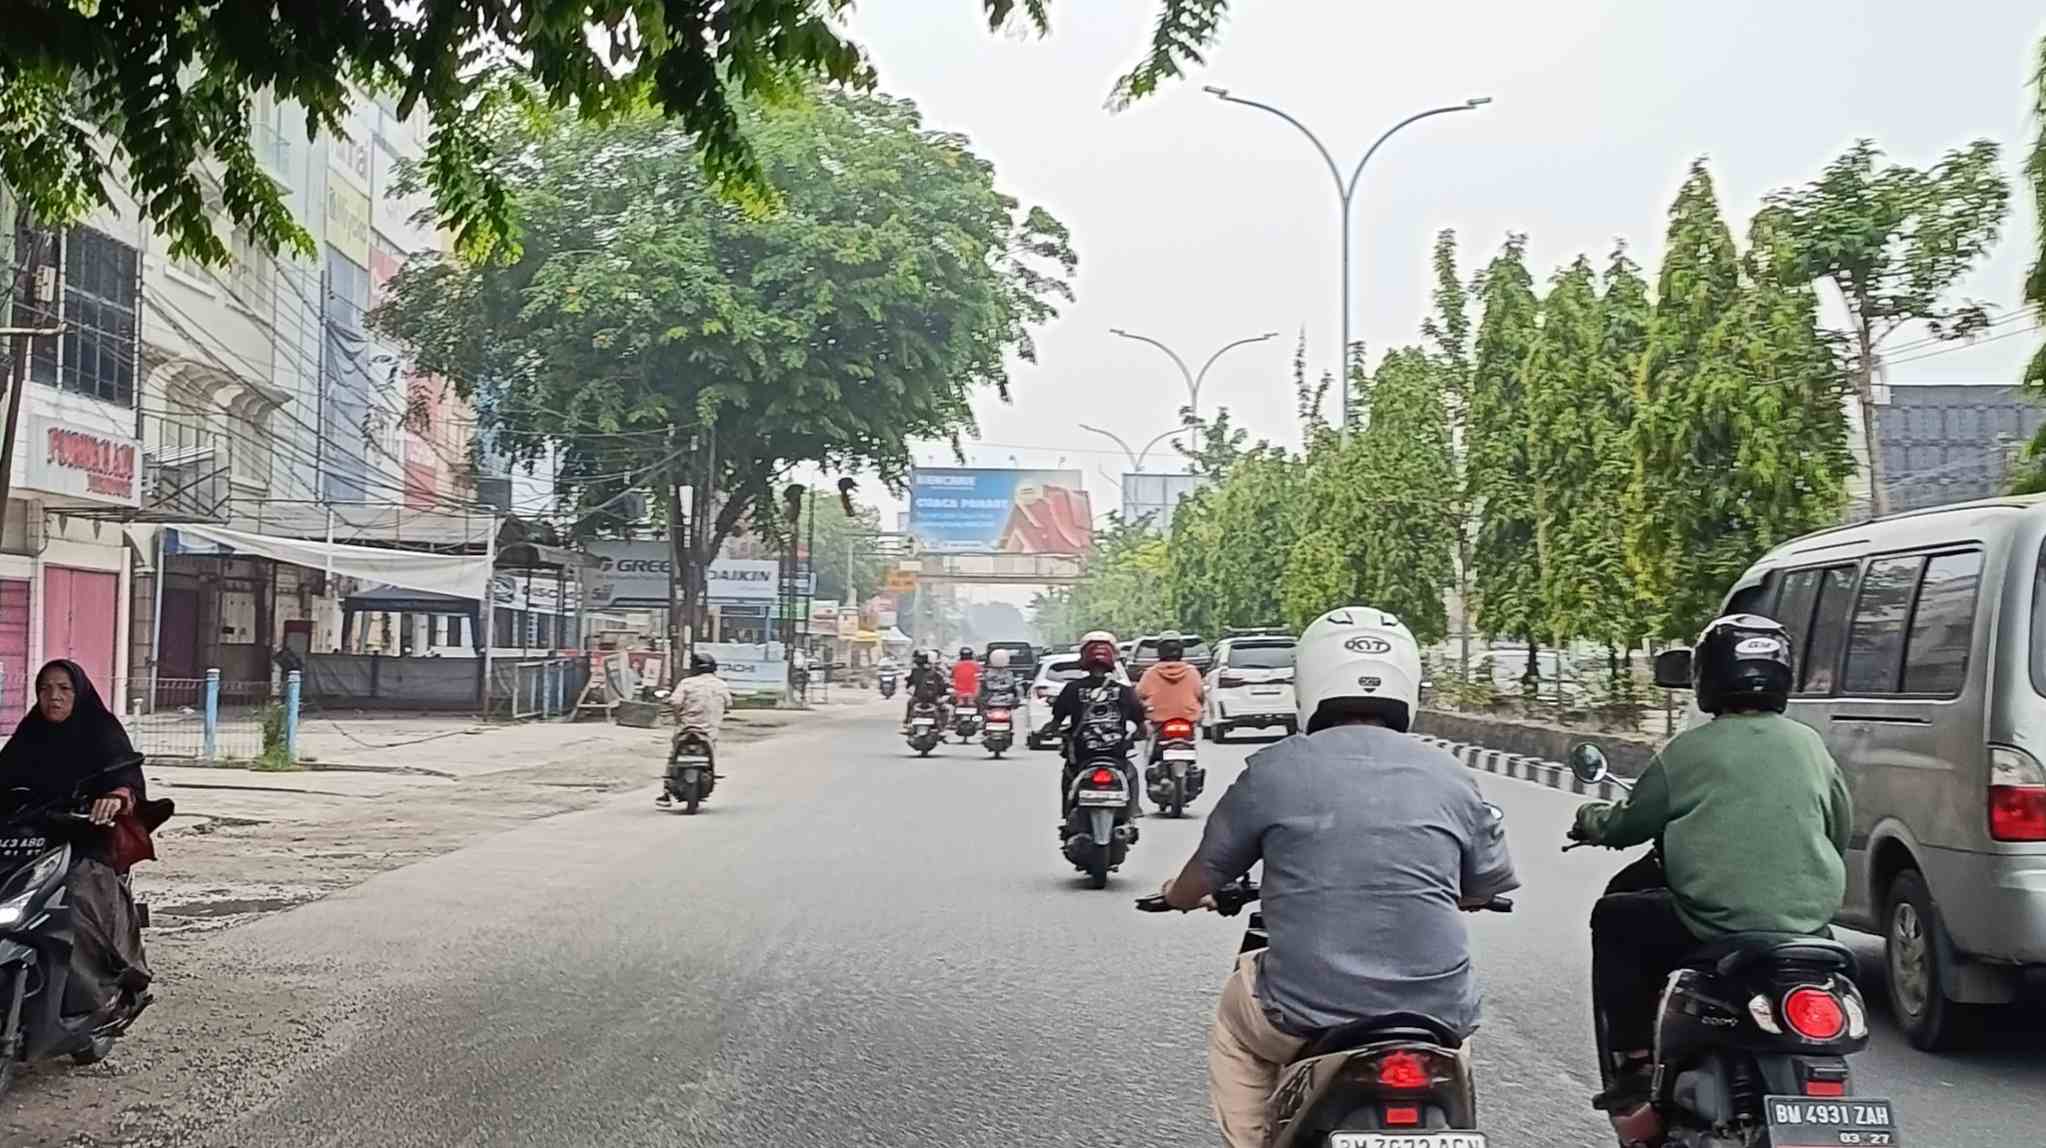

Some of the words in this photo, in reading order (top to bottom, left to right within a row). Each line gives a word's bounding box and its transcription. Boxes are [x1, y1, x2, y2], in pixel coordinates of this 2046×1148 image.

[1775, 1104, 1802, 1124] BM
[1805, 1105, 1849, 1124] 4931
[1853, 1106, 1889, 1125] ZAH
[1839, 1132, 1860, 1144] 03
[1869, 1133, 1890, 1144] 27
